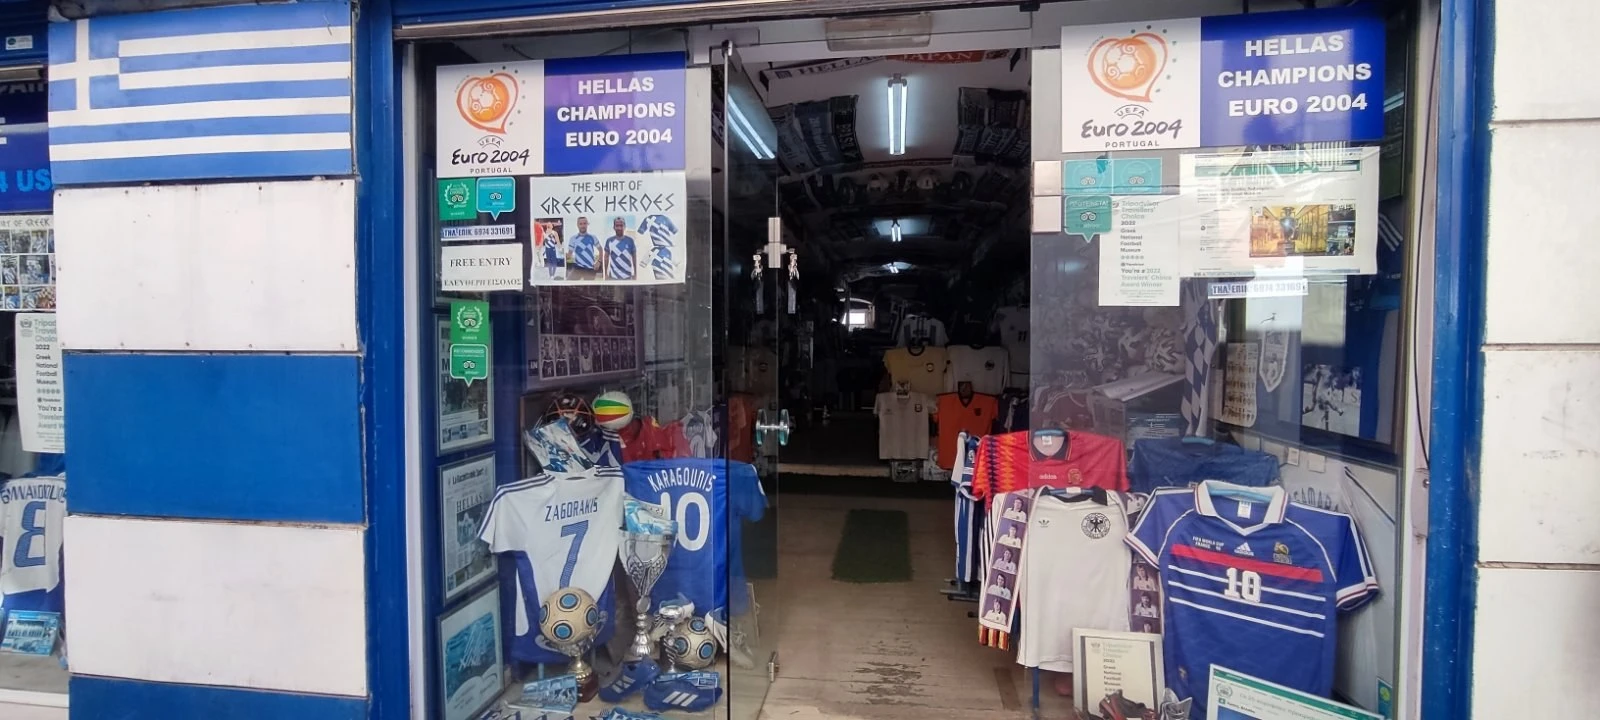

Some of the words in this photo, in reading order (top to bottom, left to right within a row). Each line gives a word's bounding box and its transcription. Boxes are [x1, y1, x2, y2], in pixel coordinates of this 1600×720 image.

[1245, 34, 1344, 57] HELLAS
[1217, 63, 1372, 88] CHAMPIONS
[578, 77, 654, 95] HELLAS
[557, 102, 676, 122] CHAMPIONS
[1116, 107, 1145, 118] UEFA
[1228, 97, 1298, 117] EURO
[1306, 93, 1367, 113] 2004
[565, 131, 619, 147] EURO
[625, 128, 672, 146] 2004
[1081, 119, 1128, 139] Euro
[1131, 118, 1183, 139] 2004
[479, 137, 502, 146] UEFA
[1105, 140, 1160, 148] PORTUGAL
[452, 148, 488, 165] Euro
[490, 148, 530, 166] 2004
[571, 182, 592, 193] THE
[594, 181, 625, 192] SHIRT
[628, 180, 643, 191] OF
[540, 195, 595, 214] GREEK
[605, 193, 675, 212] HEROES
[450, 258, 477, 267] FREE
[479, 257, 512, 267] ENTRY
[647, 467, 713, 492] KARAGOUNIS
[545, 497, 598, 521] ZAGORAKIS
[1202, 537, 1215, 545] WORLD
[560, 520, 589, 589] 7
[1224, 567, 1262, 603] 10
